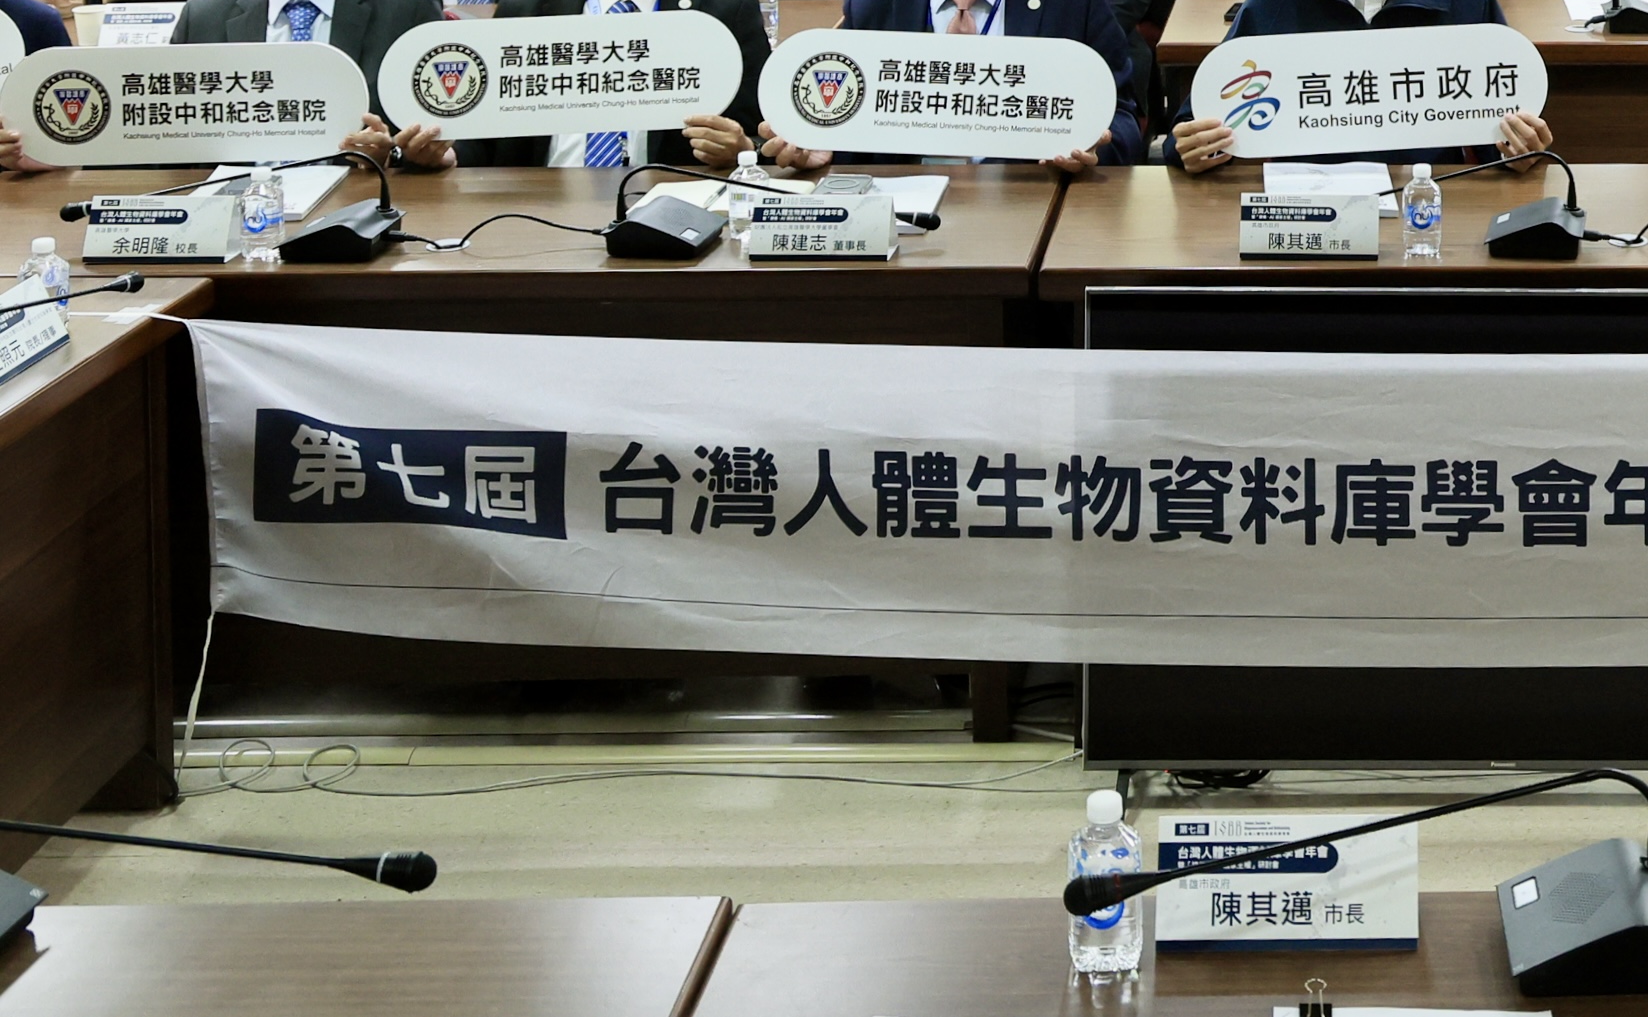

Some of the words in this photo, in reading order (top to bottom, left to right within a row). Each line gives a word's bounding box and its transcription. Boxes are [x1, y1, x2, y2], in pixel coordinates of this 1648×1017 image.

[500, 39, 650, 69] 高雄醫學大學
[121, 70, 274, 96] 高雄醫學大學
[499, 66, 701, 99] 附設中和紀念醫院
[878, 59, 1026, 87] 高雄醫學大學
[1297, 62, 1519, 109] 高雄市政府
[122, 99, 326, 126] 附設中和紀念醫院
[566, 102, 601, 110] University
[602, 100, 637, 108] Chung-Ho
[639, 98, 669, 106] Memorial
[672, 97, 699, 105] Hospital
[875, 90, 1074, 120] 附設中和紀念醫院
[1298, 114, 1383, 129] Kaohsiung
[1388, 110, 1418, 126] City
[1424, 104, 1520, 122] Government
[874, 120, 909, 128] Kaohsiung
[939, 122, 973, 131] University
[975, 123, 1009, 132] Chung-Ho
[1011, 125, 1042, 133] Memorial
[1044, 127, 1071, 135] Hospital
[112, 236, 169, 254] 余明隆
[175, 242, 198, 254] 校長
[772, 234, 827, 251] 陳建志
[833, 240, 866, 251] 董事長
[1268, 233, 1322, 250] 陳其邁
[1329, 240, 1351, 250] 市長
[290, 422, 538, 526] 第七屆
[1178, 824, 1206, 834] 第七屆
[1178, 878, 1230, 890] 高雄市政府
[1211, 891, 1313, 926] 陳其邁
[1324, 902, 1365, 924] 市長
